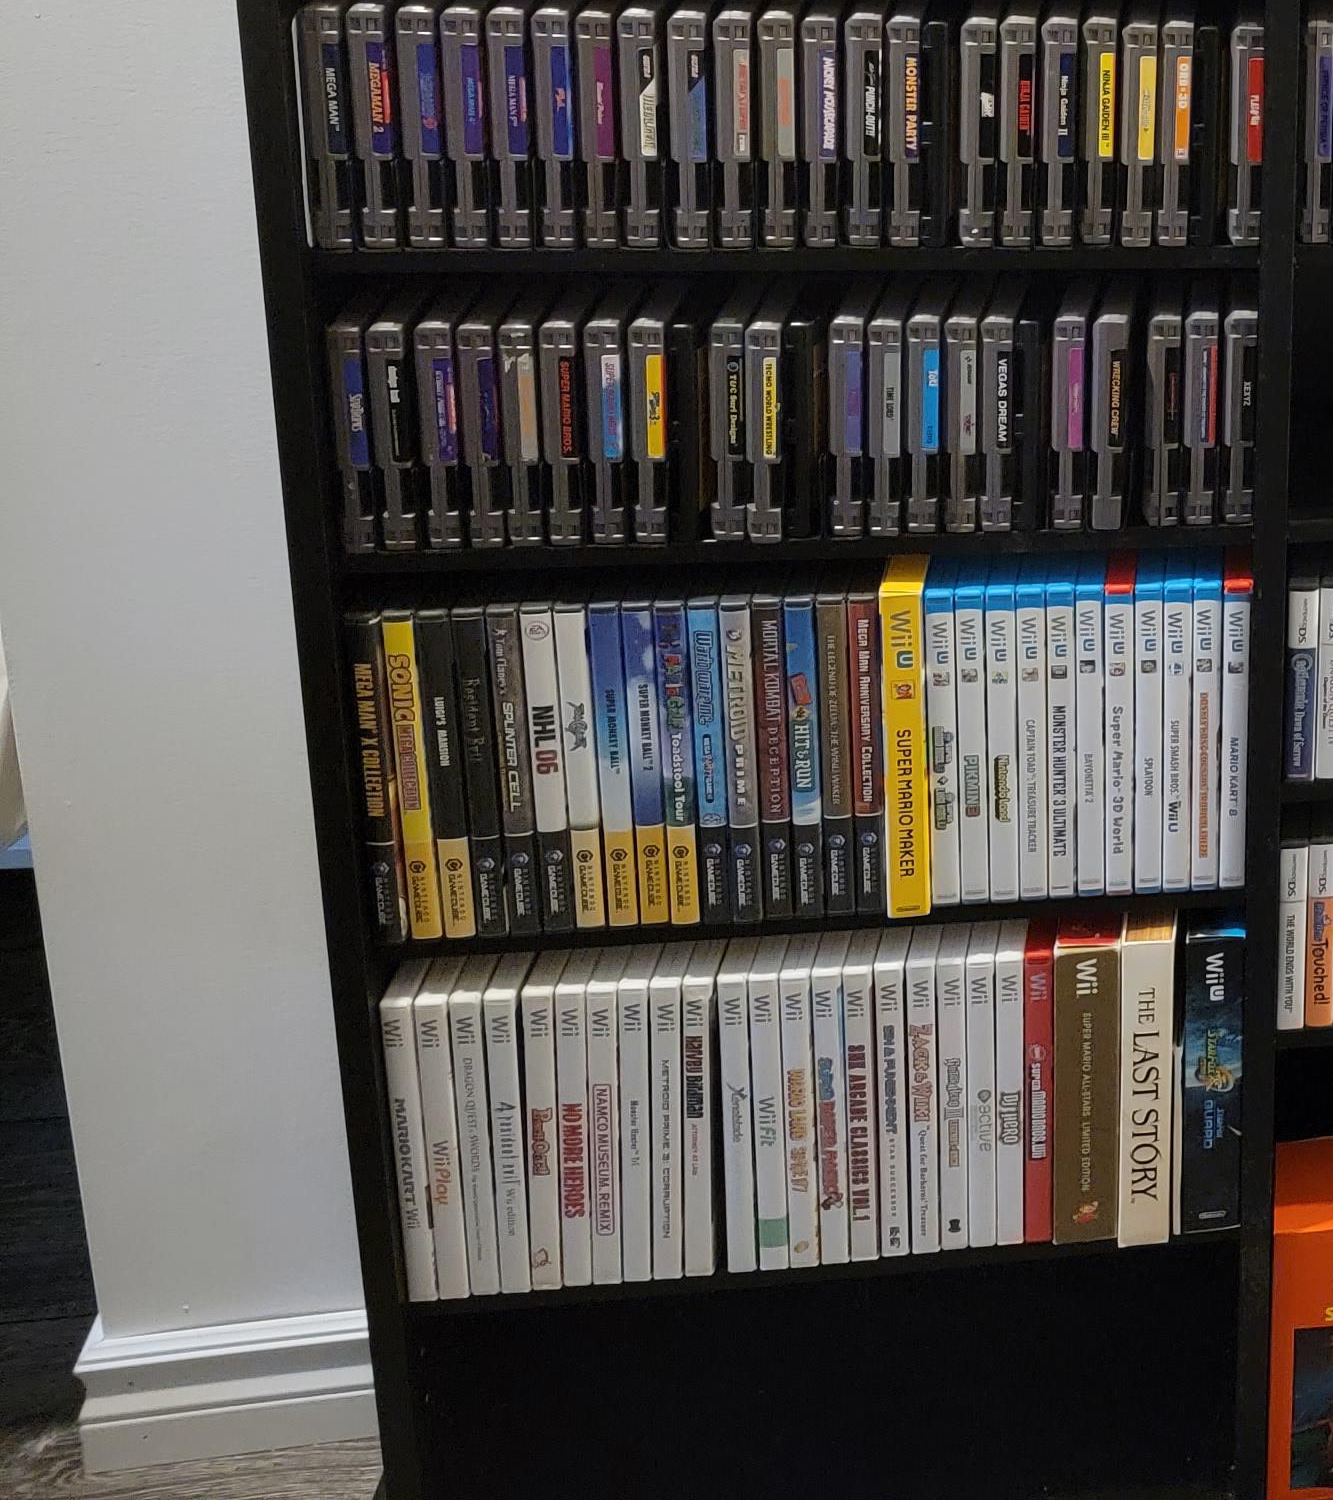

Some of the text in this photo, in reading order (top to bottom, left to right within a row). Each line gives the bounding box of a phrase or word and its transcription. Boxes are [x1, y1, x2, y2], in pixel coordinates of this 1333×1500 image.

[905, 57, 917, 151] MONSTER PARTY
[997, 358, 1009, 442] VEGAS DREAM
[531, 705, 560, 776] NHL 06
[669, 732, 684, 822] Toadstool Tour
[896, 729, 915, 879] SUPER MARIO MAKER
[1076, 958, 1098, 999] Wii
[1312, 938, 1331, 1006] Touched!
[421, 1020, 440, 1049] Wii
[1131, 987, 1160, 1203] THE LAST STORY
[562, 1102, 586, 1219] NO MORE HEROES
